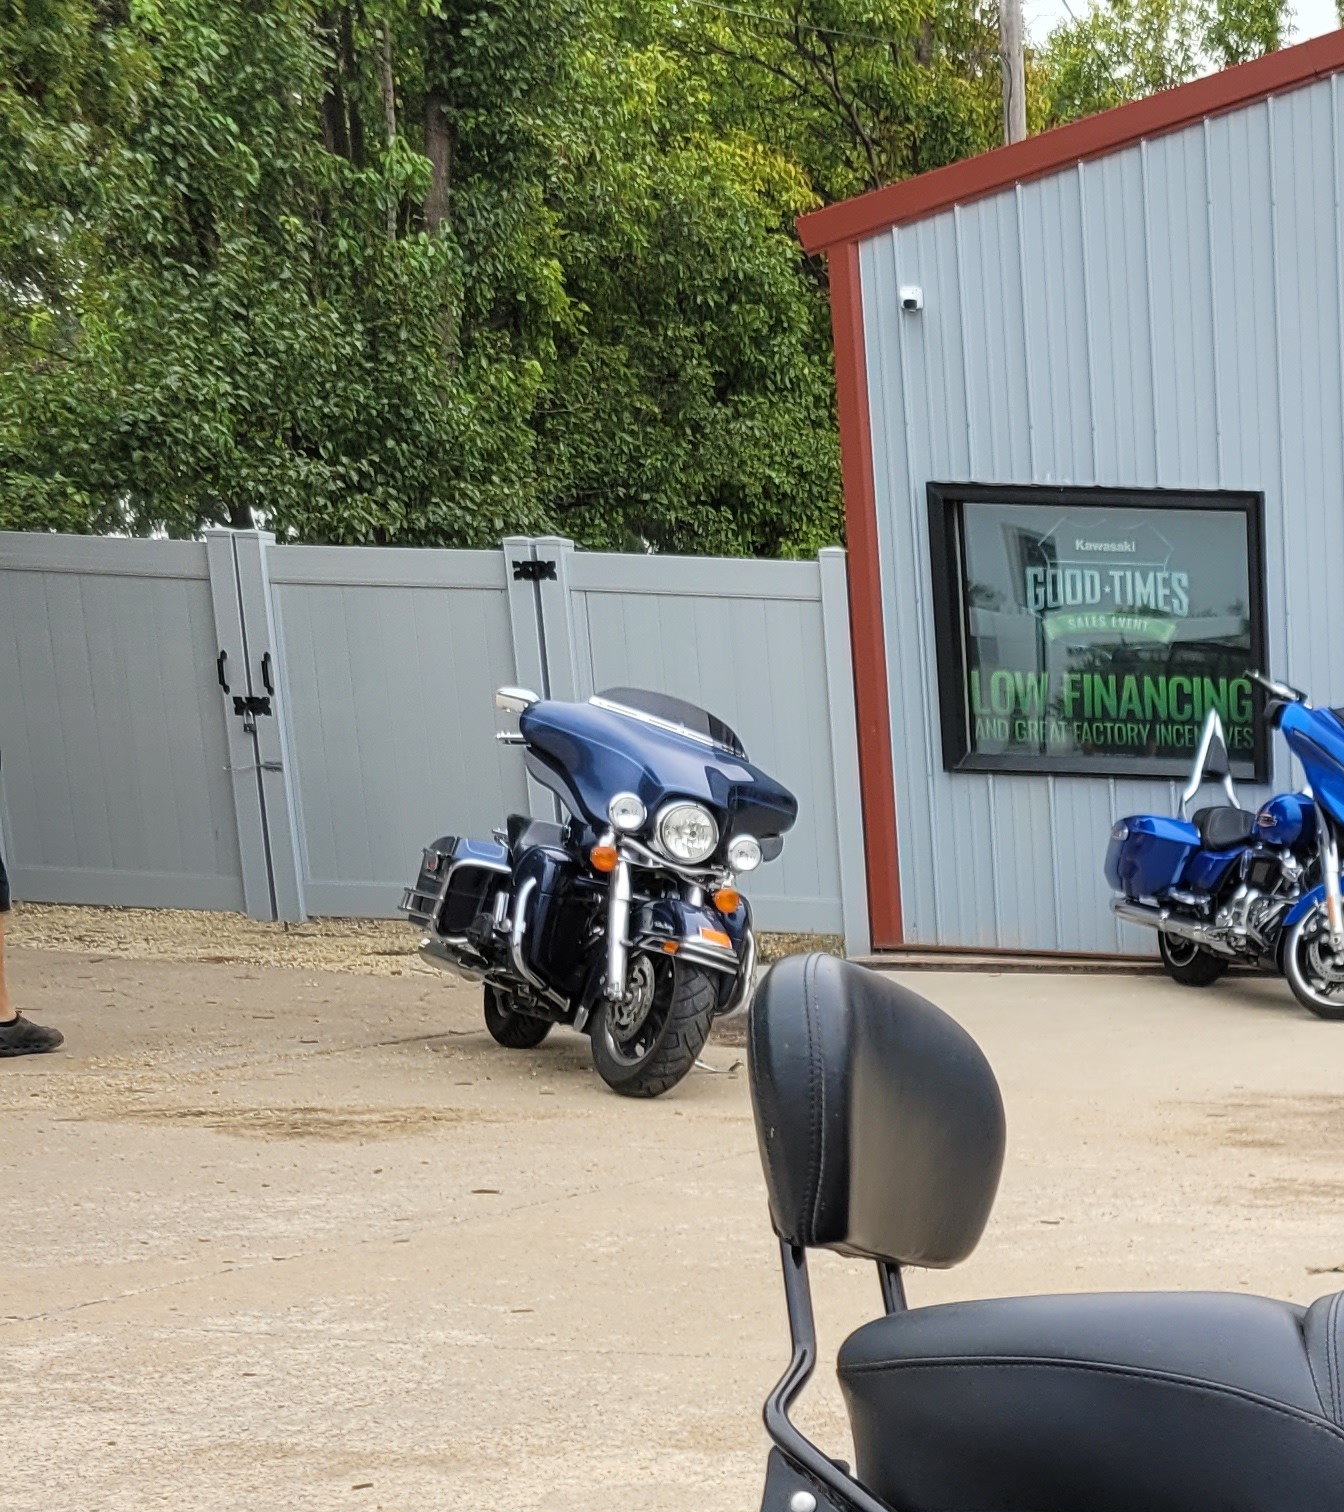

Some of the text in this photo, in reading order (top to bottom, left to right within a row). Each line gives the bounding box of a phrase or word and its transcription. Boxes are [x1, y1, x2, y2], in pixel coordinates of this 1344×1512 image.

[1075, 538, 1137, 553] Kawasaki
[1025, 566, 1189, 617] GOOD TIMES
[1067, 615, 1149, 632] SALES EVENT
[970, 669, 1253, 724] LOW FINANCING
[974, 718, 1009, 742] AND
[1014, 719, 1067, 744] GREAT
[1073, 721, 1151, 747] FACTORY
